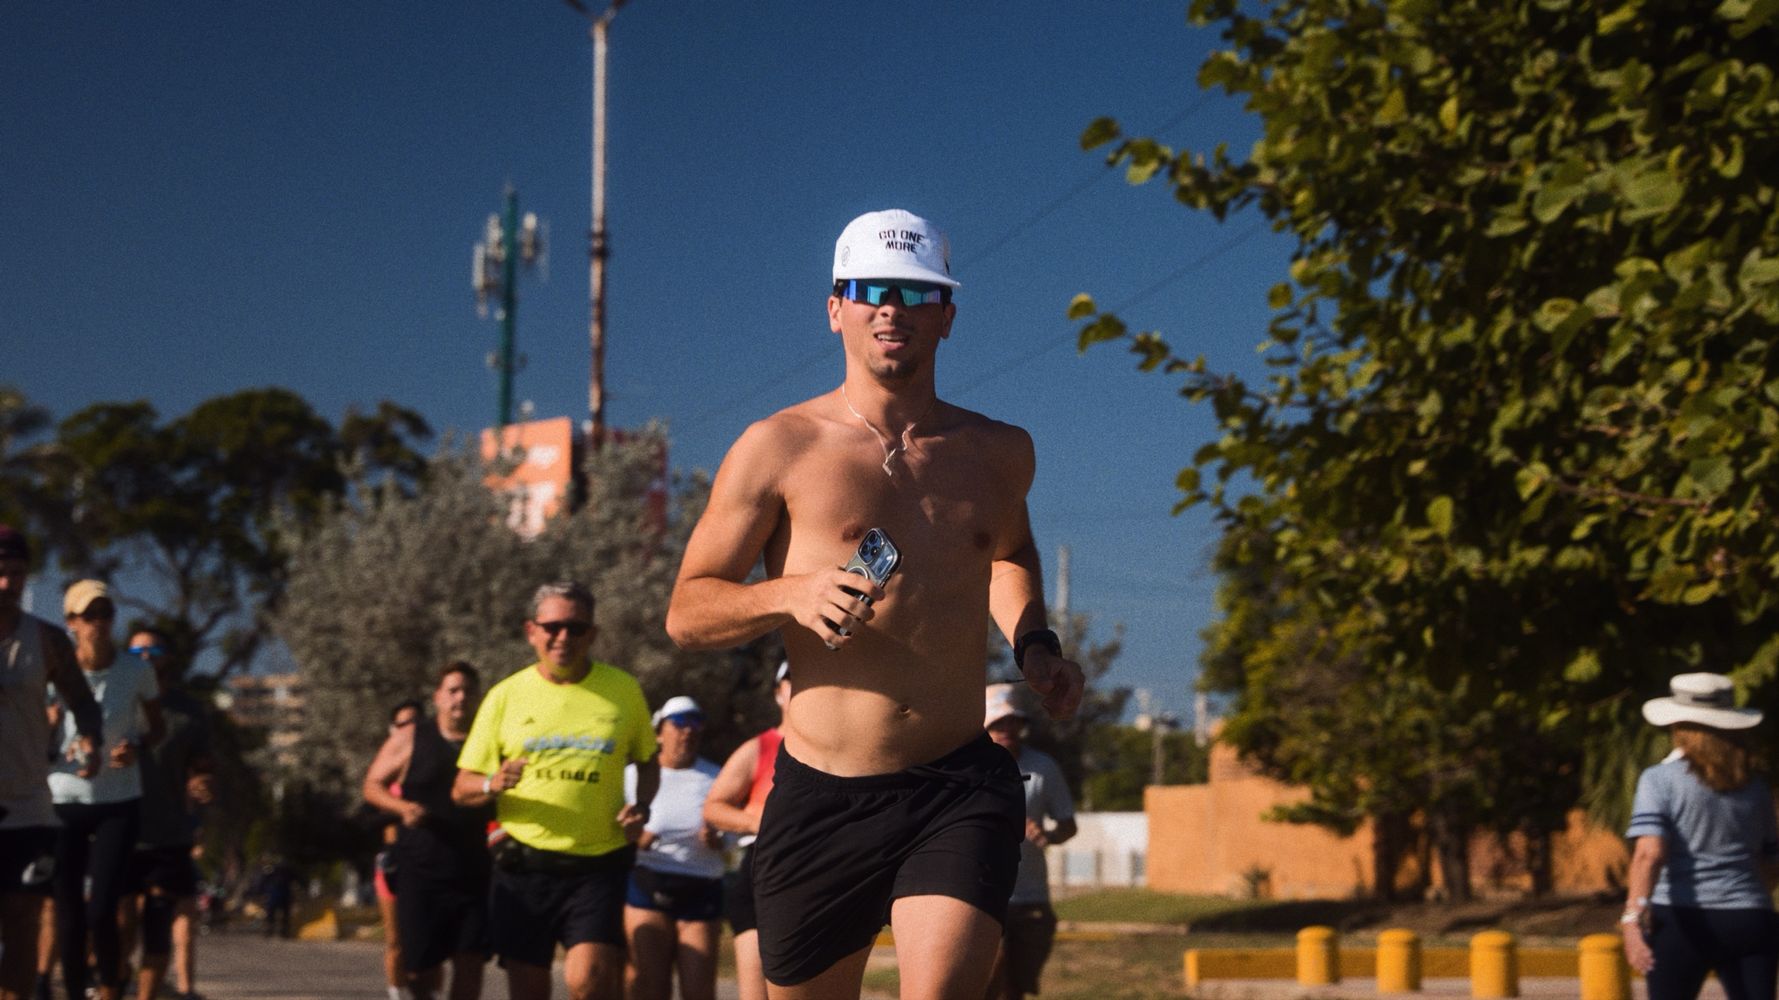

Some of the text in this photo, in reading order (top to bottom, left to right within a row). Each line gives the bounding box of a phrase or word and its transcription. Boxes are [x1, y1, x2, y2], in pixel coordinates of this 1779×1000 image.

[879, 229, 926, 246] GO ONE
[885, 240, 918, 255] MORE
